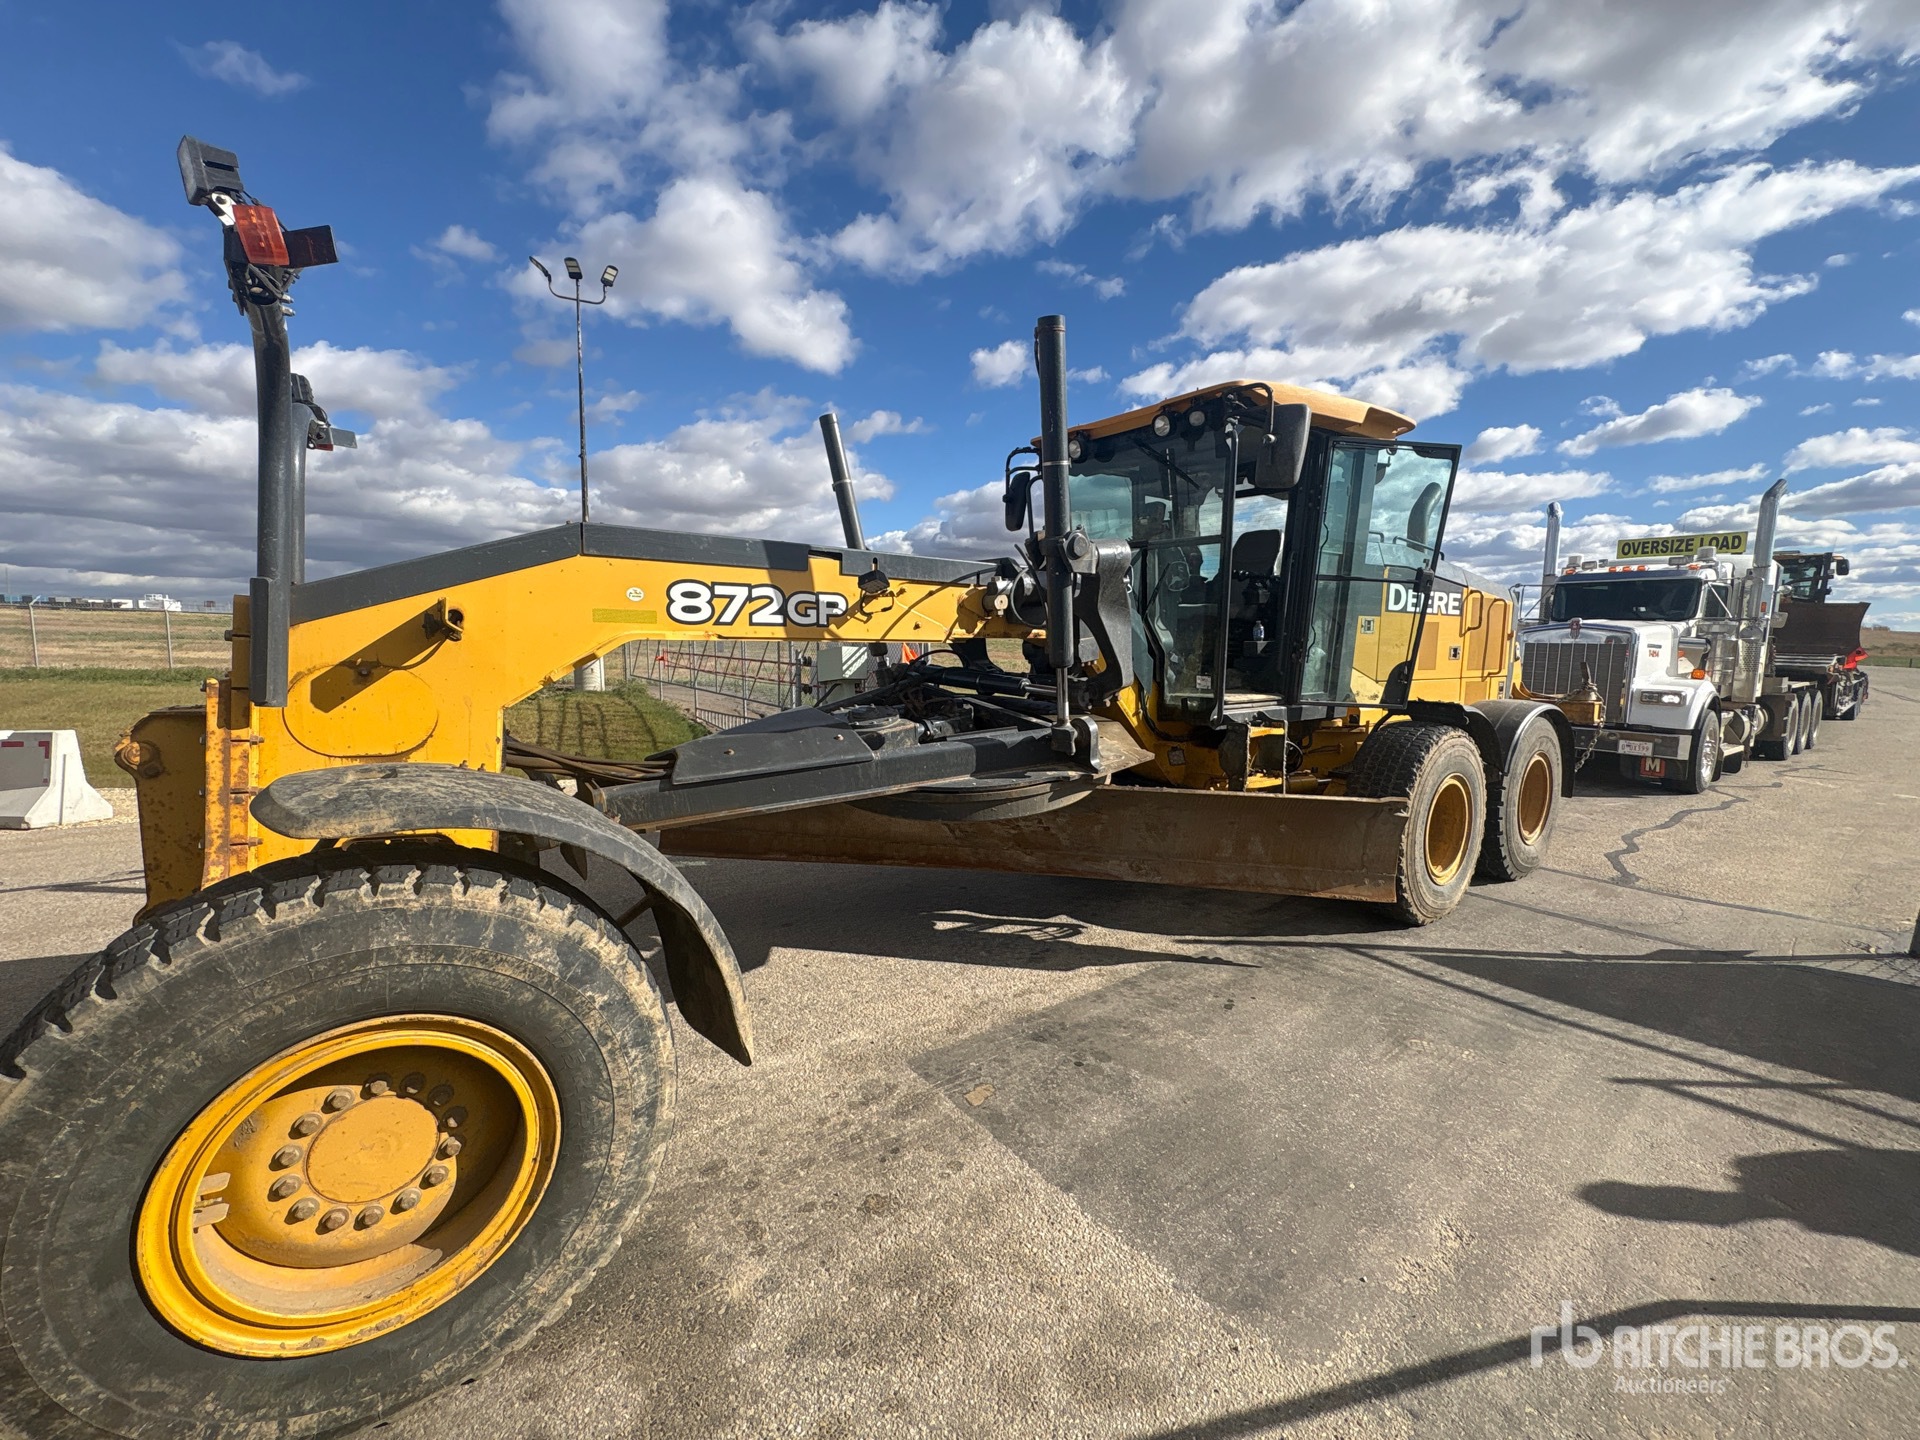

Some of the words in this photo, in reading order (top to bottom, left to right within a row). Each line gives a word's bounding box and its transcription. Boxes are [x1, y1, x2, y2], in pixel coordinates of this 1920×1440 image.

[1622, 540, 1693, 556] OVERSIZE
[667, 580, 848, 627] 872GP
[1388, 583, 1461, 615] DEERE
[1645, 757, 1660, 773] M
